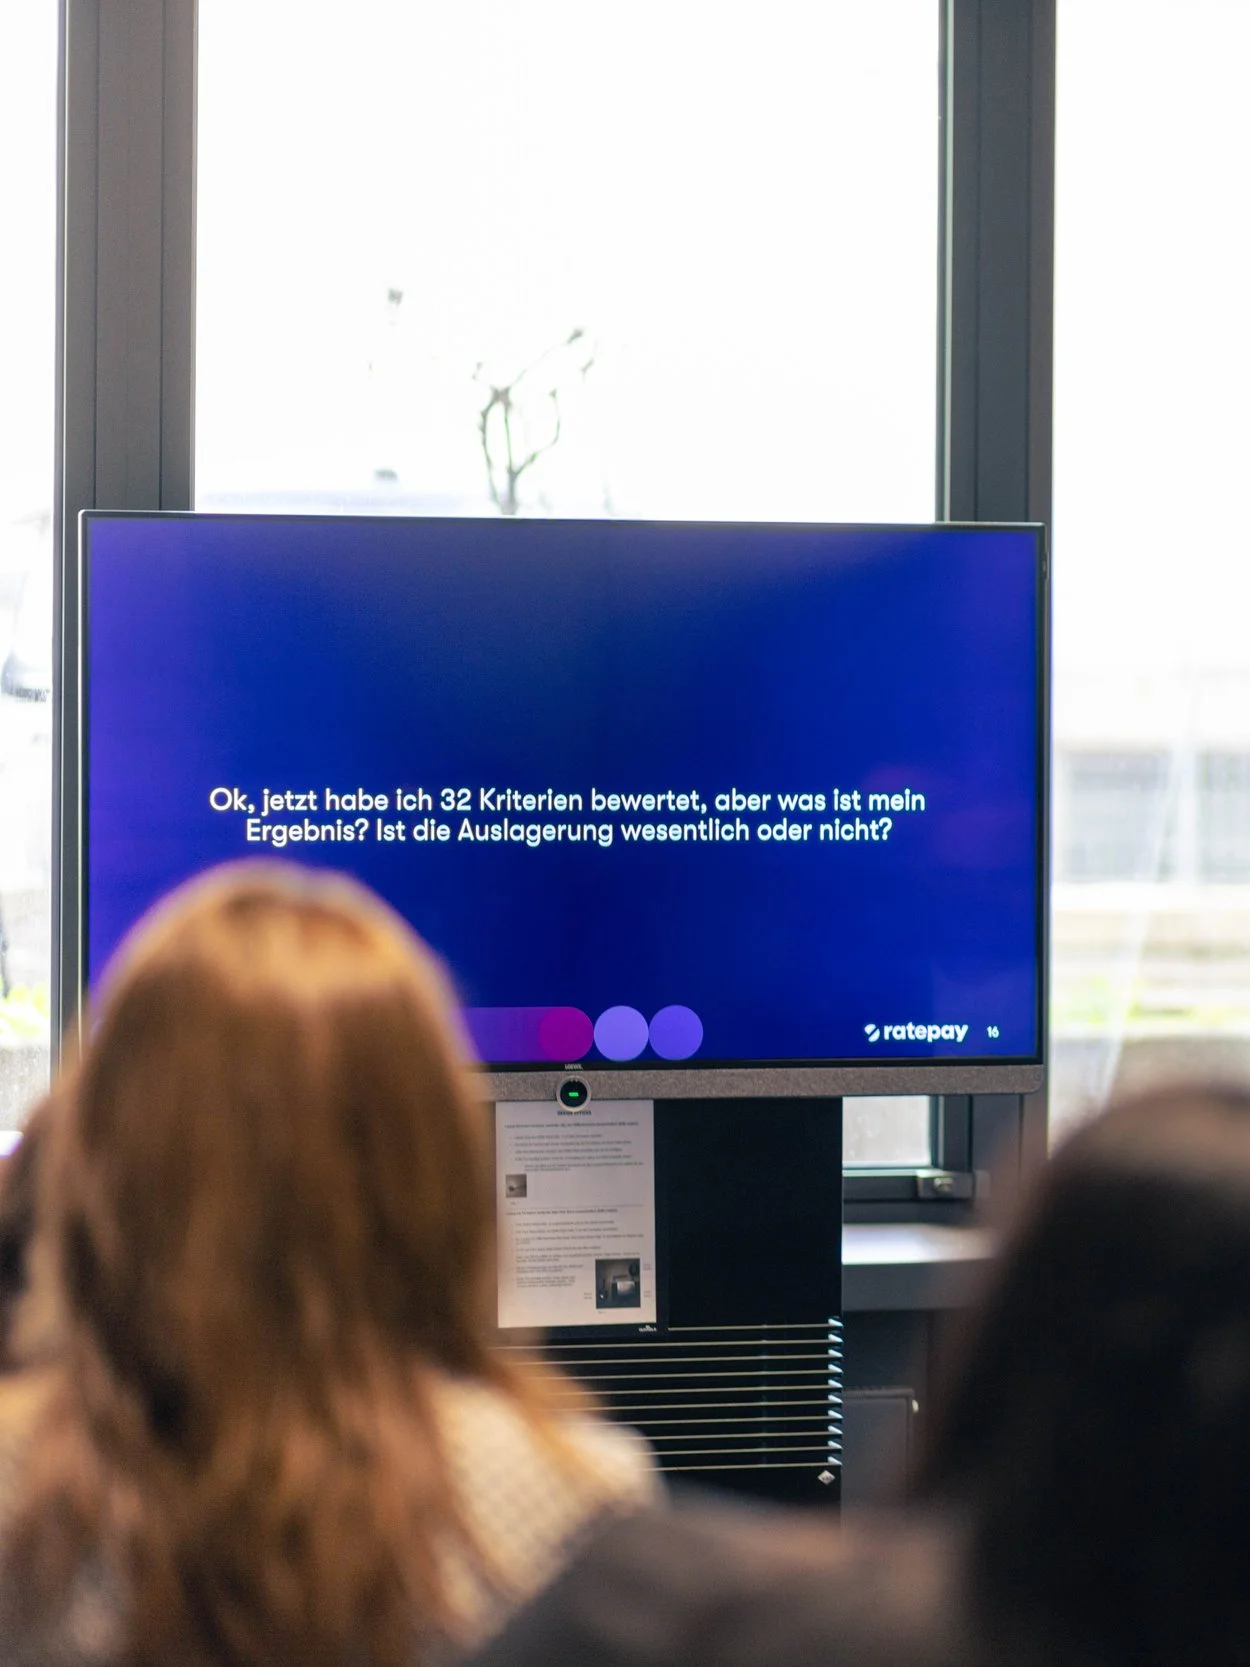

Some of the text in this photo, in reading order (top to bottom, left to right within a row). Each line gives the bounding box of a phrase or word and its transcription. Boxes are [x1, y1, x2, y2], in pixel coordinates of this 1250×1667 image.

[209, 787, 926, 817] Ok, jetzt habe ich 32 Kriterien bewertet, aber was ist mein
[246, 817, 893, 848] Ergebnis? Ist die Auslagerung wesentlich oder nicht?
[883, 1021, 969, 1043] ratepay
[986, 1025, 1000, 1039] 16
